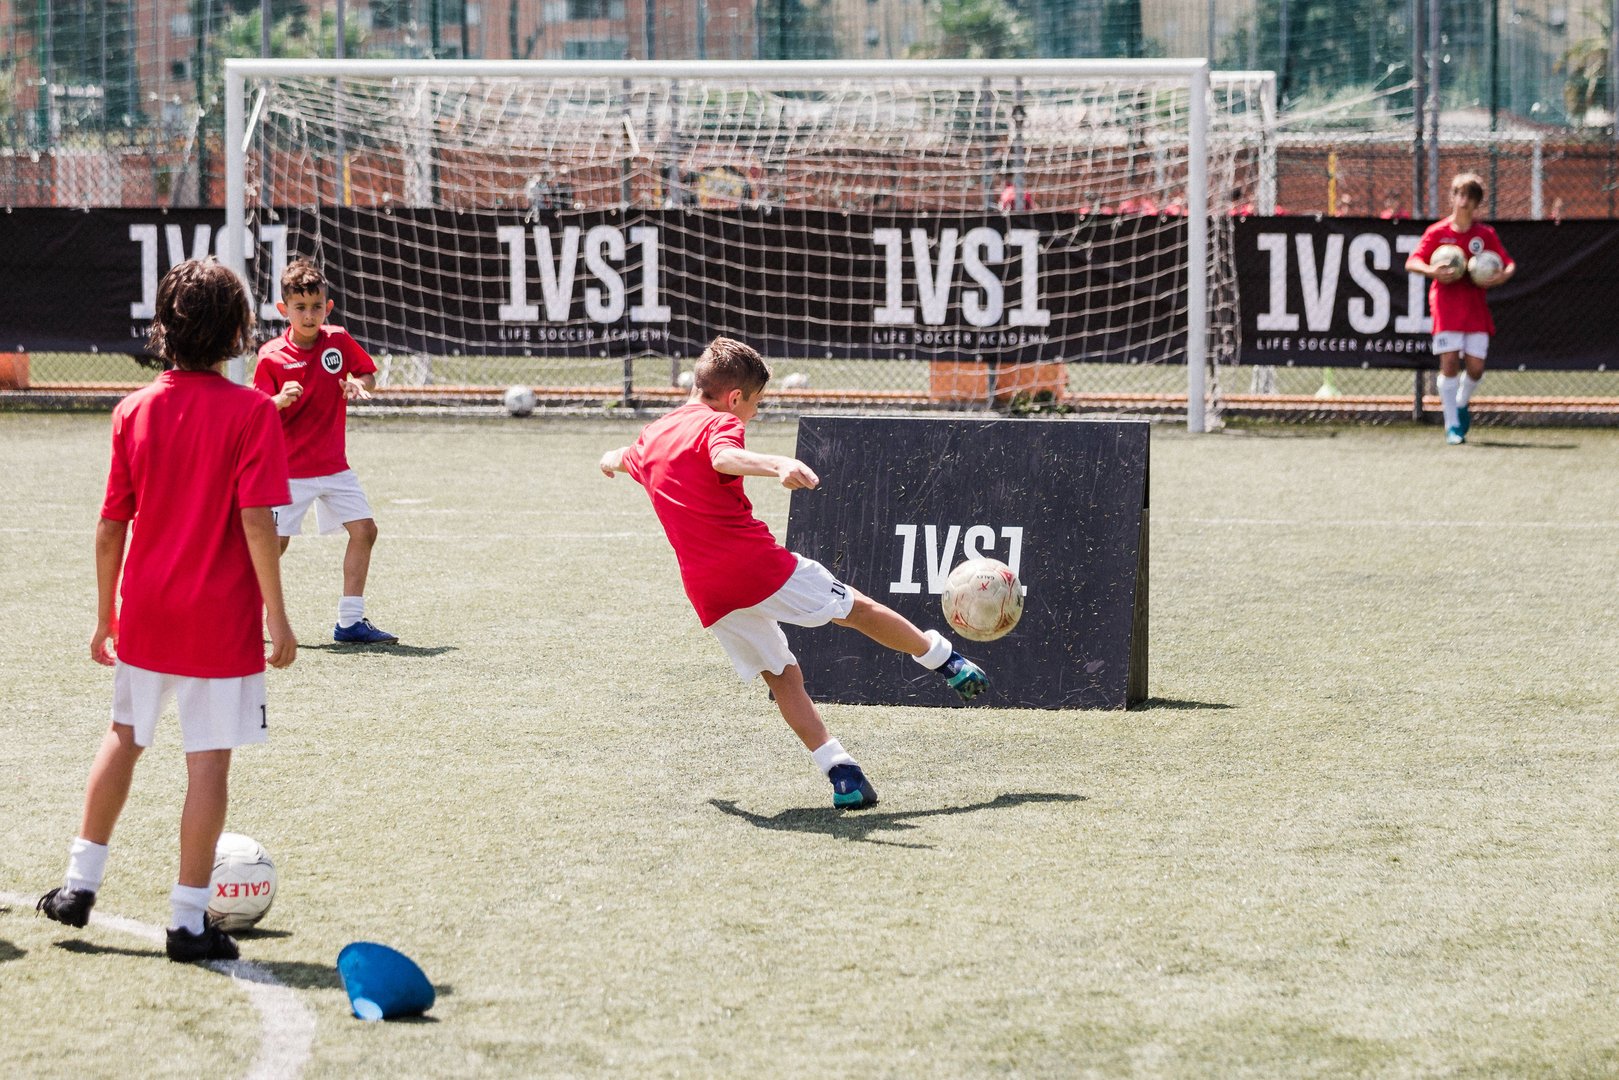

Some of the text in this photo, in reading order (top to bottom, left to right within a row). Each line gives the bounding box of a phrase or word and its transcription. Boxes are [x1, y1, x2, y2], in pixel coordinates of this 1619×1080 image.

[496, 224, 672, 324] 1VS1
[872, 226, 1052, 327] 1VS1
[1256, 233, 1433, 335] 1VS1
[498, 328, 672, 343] LIFE SOCCER ACADEMY
[873, 331, 1050, 346] LIFE SOCCER ACADEMY
[1256, 336, 1290, 350] LIFE
[1298, 337, 1357, 351] SOCCER
[216, 880, 271, 898] GALEX
